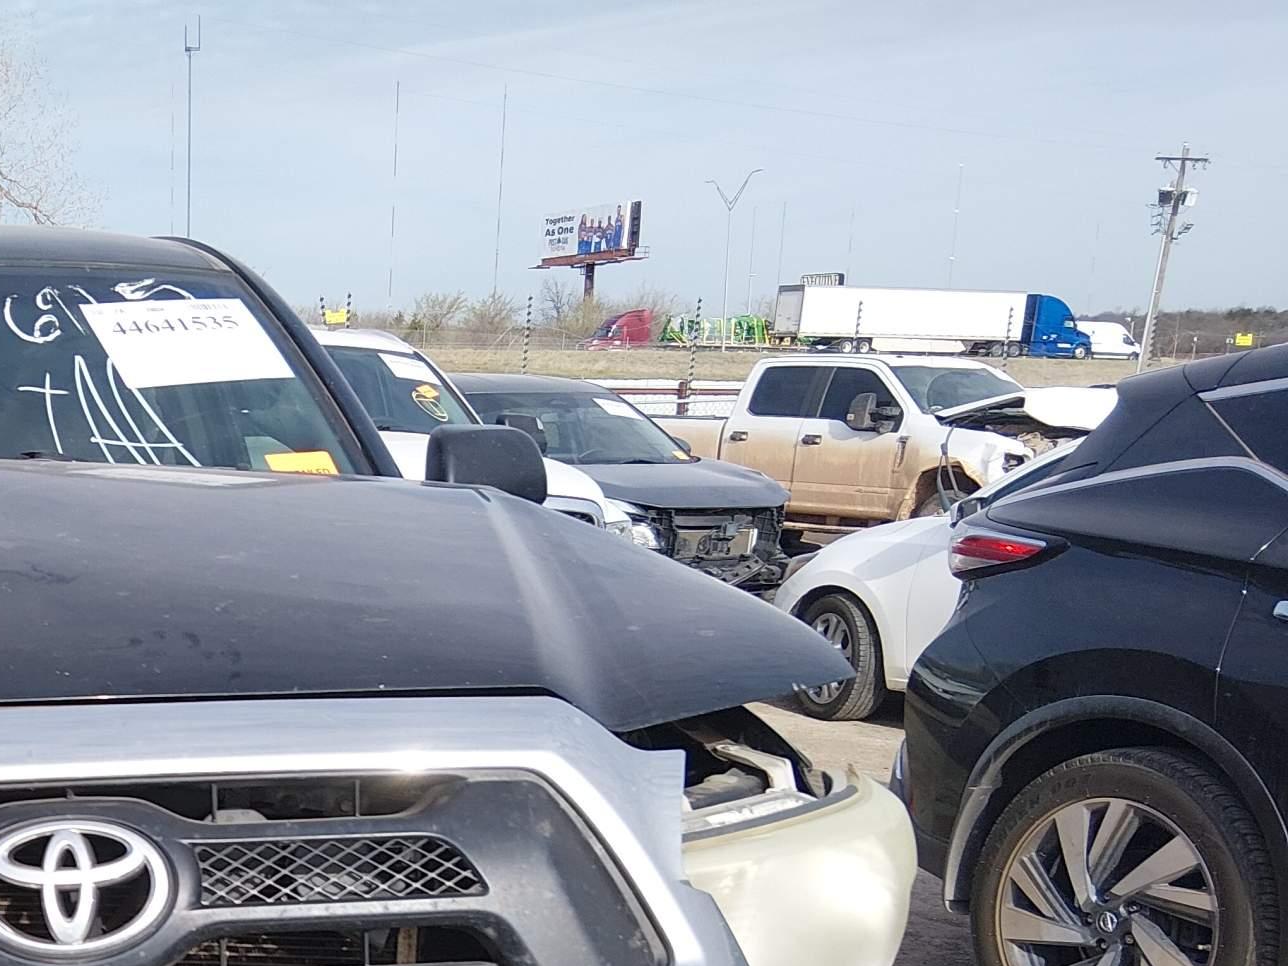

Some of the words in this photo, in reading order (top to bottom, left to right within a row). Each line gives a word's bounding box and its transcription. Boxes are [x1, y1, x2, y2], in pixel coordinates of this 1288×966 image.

[545, 215, 575, 226] Together
[544, 228, 556, 238] As
[557, 225, 574, 236] One
[112, 315, 240, 336] 44641535
